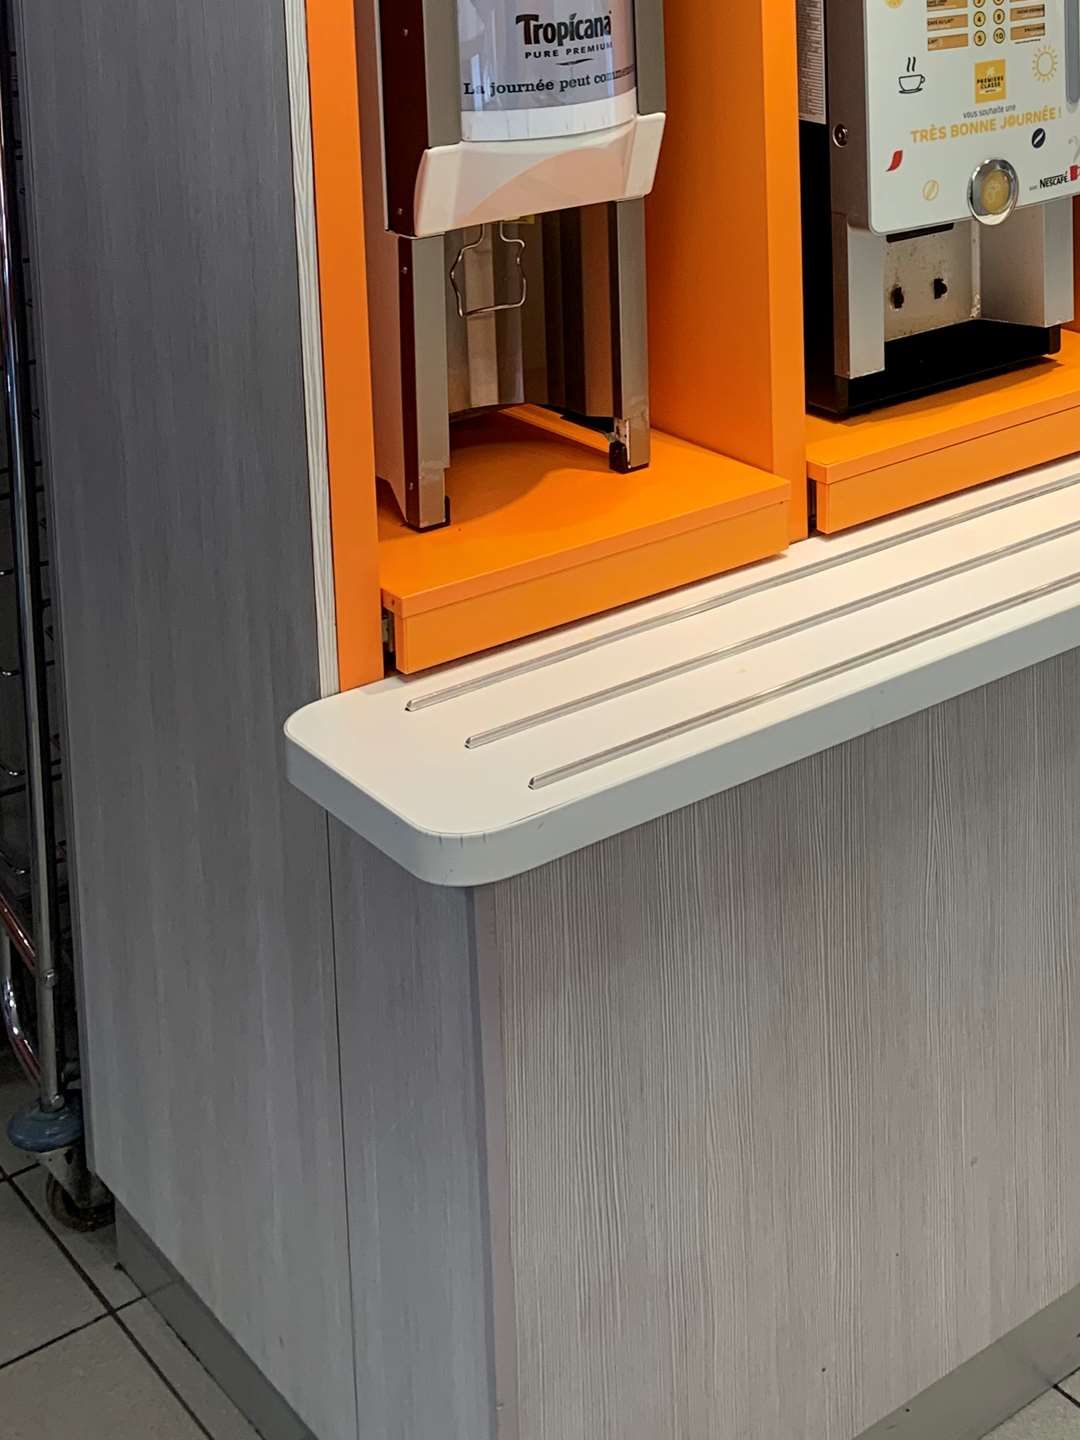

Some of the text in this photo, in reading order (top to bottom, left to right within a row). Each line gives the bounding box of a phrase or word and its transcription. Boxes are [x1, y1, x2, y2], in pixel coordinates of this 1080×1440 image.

[515, 12, 612, 46] Tropicana
[525, 42, 613, 59] PURE PREMIUM
[464, 83, 485, 95] La
[489, 75, 555, 96] journée
[560, 75, 591, 92] peut
[911, 125, 947, 144] TRÈS
[950, 119, 997, 138] BONNE
[1001, 105, 1057, 129] JOURNÉE
